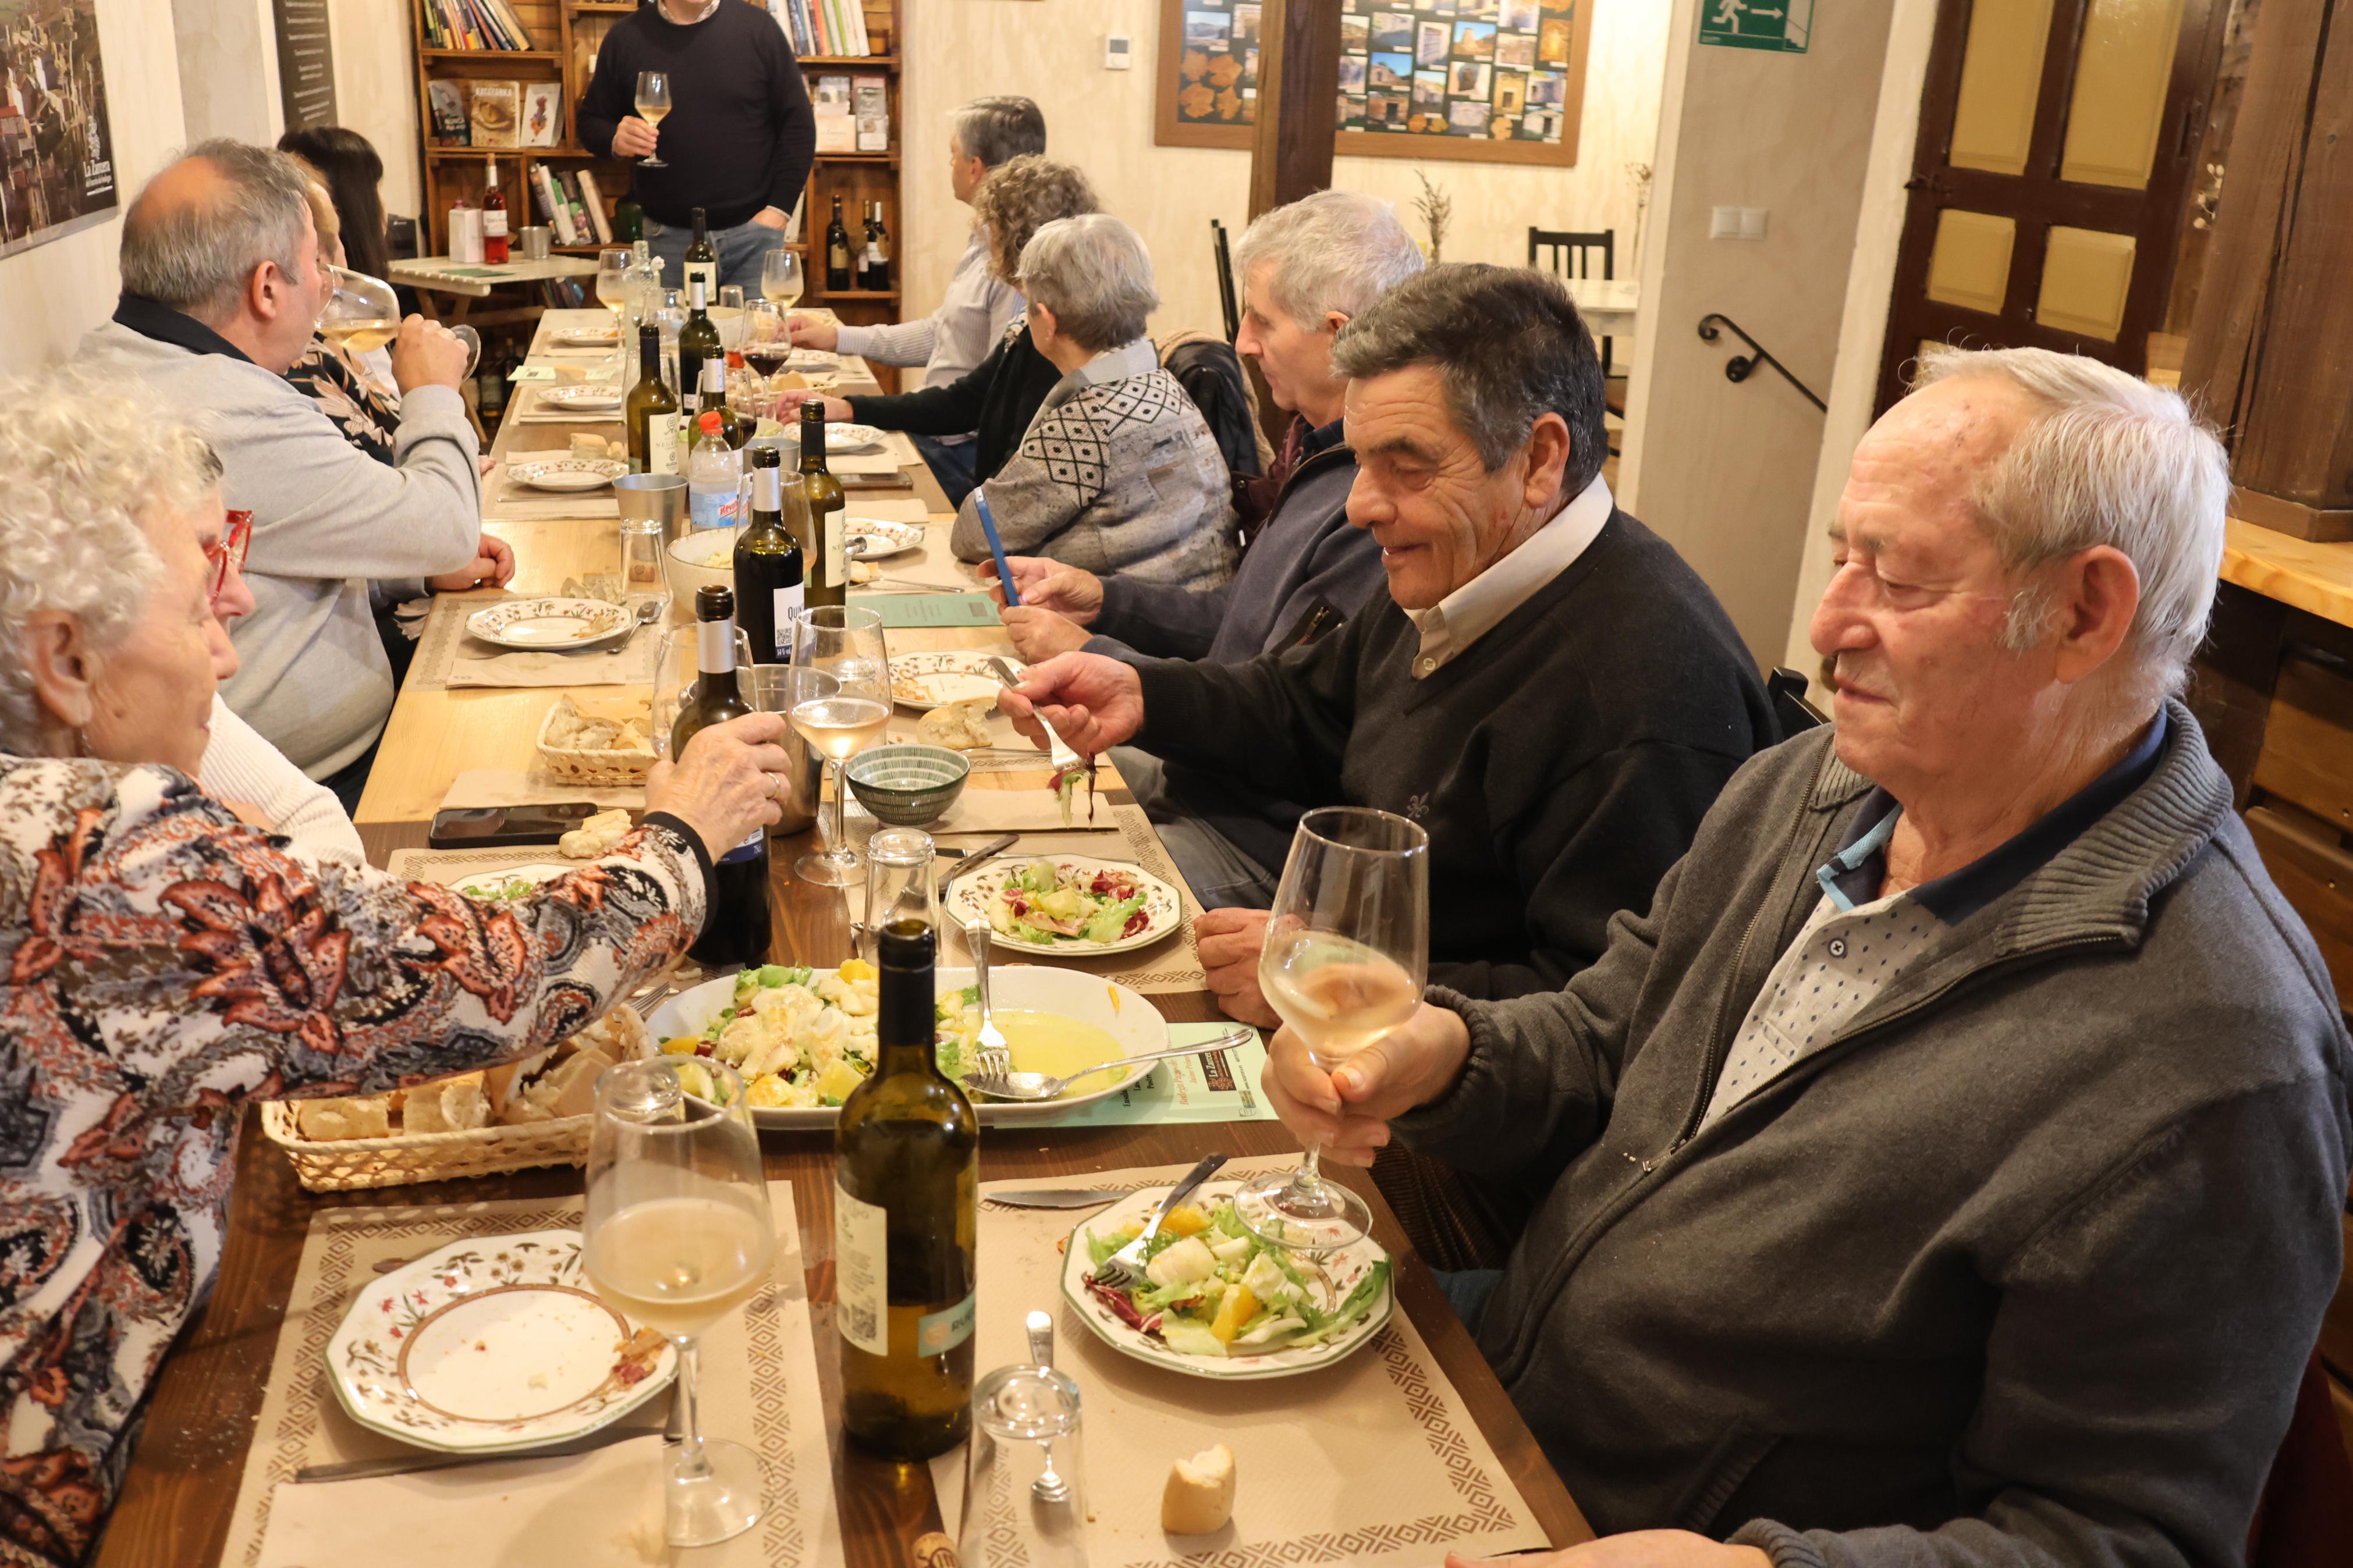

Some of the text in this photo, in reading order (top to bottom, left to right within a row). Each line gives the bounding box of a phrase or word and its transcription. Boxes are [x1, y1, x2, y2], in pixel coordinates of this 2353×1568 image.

[1204, 1052, 1216, 1070] Zarcer
[1209, 1069, 1218, 1078] La
[1119, 1089, 1131, 1107] Ensala
